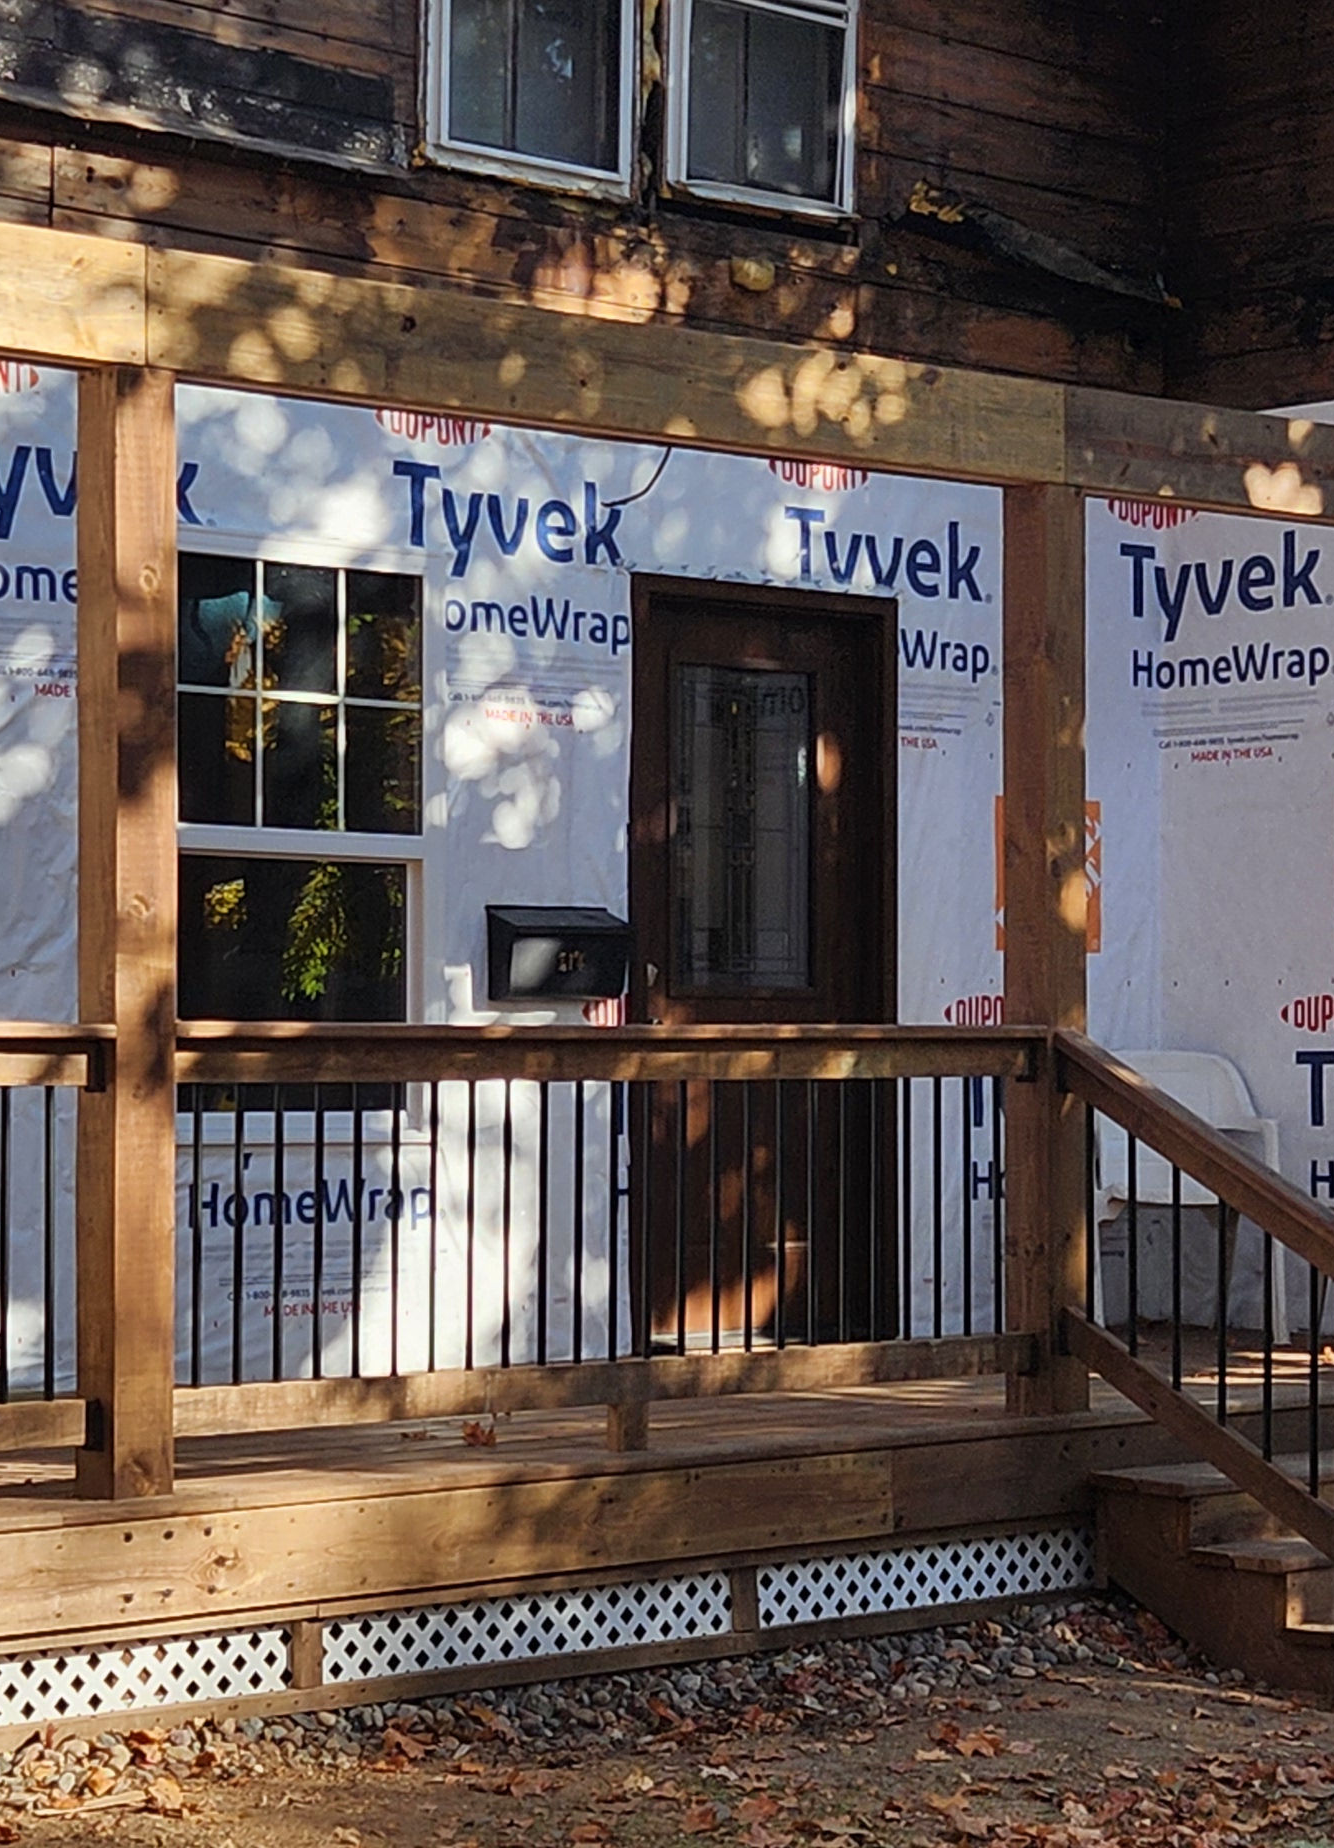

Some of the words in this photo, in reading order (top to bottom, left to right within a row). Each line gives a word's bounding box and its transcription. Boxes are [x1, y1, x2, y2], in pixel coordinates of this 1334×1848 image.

[393, 460, 624, 577] Tyvek
[784, 505, 983, 602] Tyvek
[1119, 530, 1323, 641] Tyvek
[444, 596, 630, 656] omeWrap
[899, 628, 990, 683] Wrap
[1132, 642, 1330, 690] HomeWrap
[34, 683, 71, 697] MADE
[485, 708, 516, 722] MADE
[519, 710, 533, 723] IN
[536, 712, 554, 724] THE
[555, 713, 574, 726] USA
[1191, 751, 1218, 762] MADE
[1222, 750, 1232, 761] IN
[1234, 749, 1252, 760] THE
[1254, 747, 1273, 758] USA
[188, 1179, 435, 1231] HomeWrap
[264, 1303, 299, 1318] MDE
